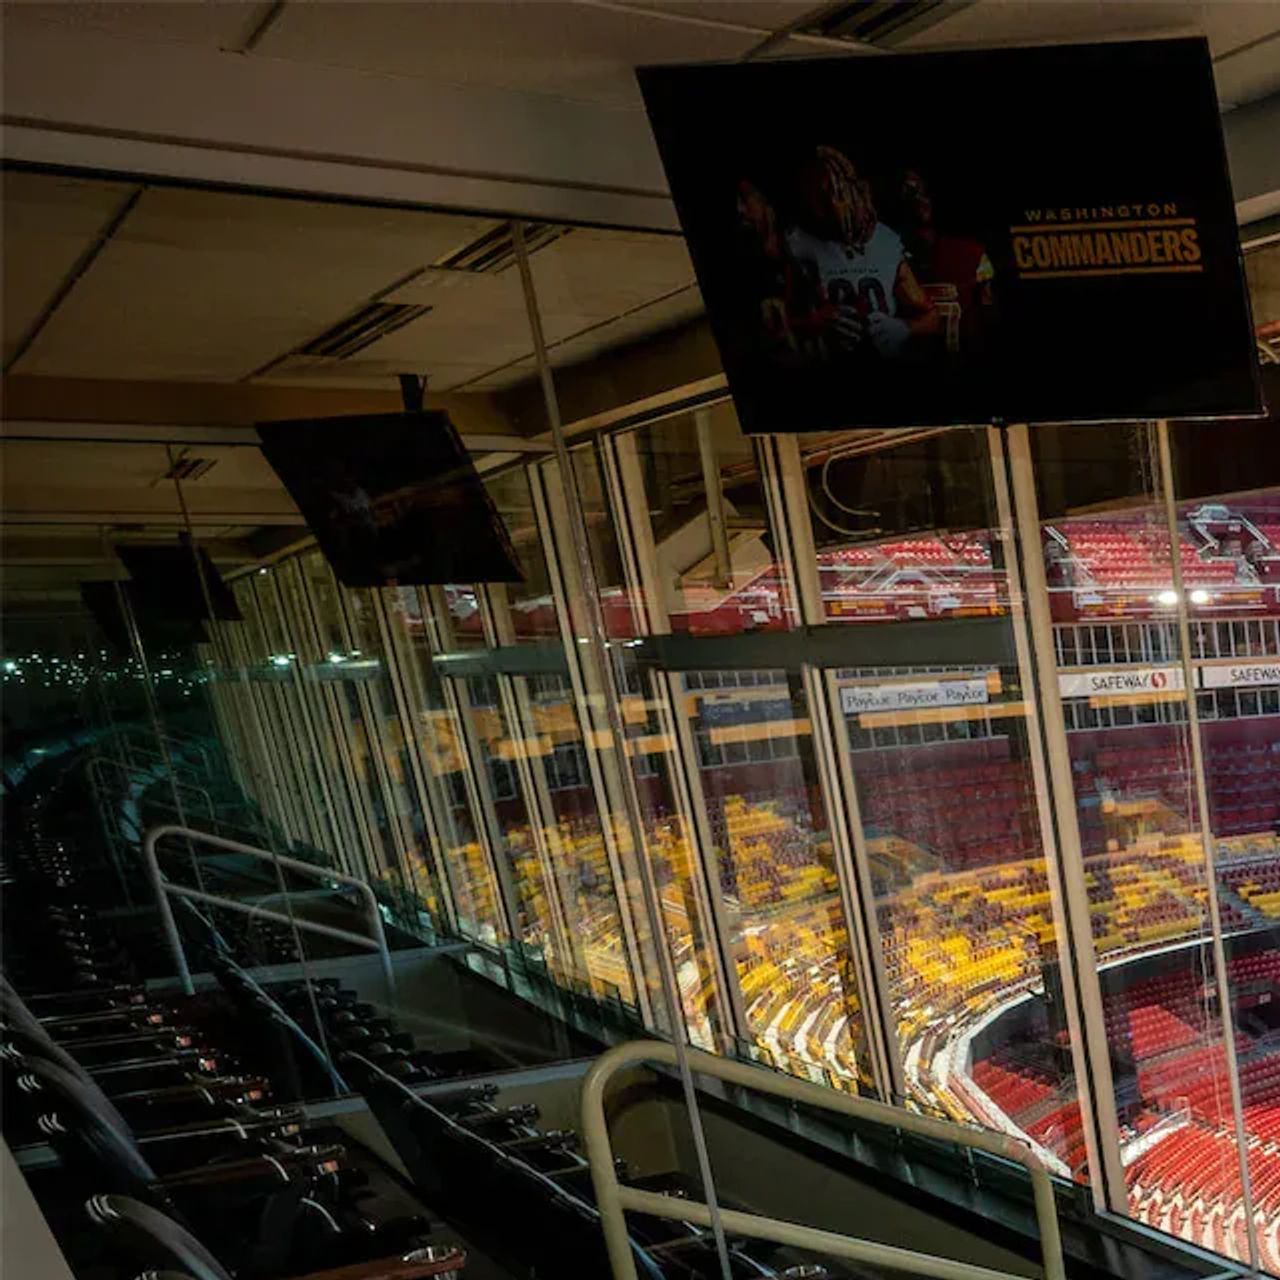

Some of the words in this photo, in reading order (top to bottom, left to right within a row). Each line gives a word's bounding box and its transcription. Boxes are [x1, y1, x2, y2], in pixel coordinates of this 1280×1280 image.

[1024, 202, 1178, 222] WASHINGTON
[1013, 228, 1201, 269] COMMANDERS
[1091, 673, 1149, 691] SAFEWAY
